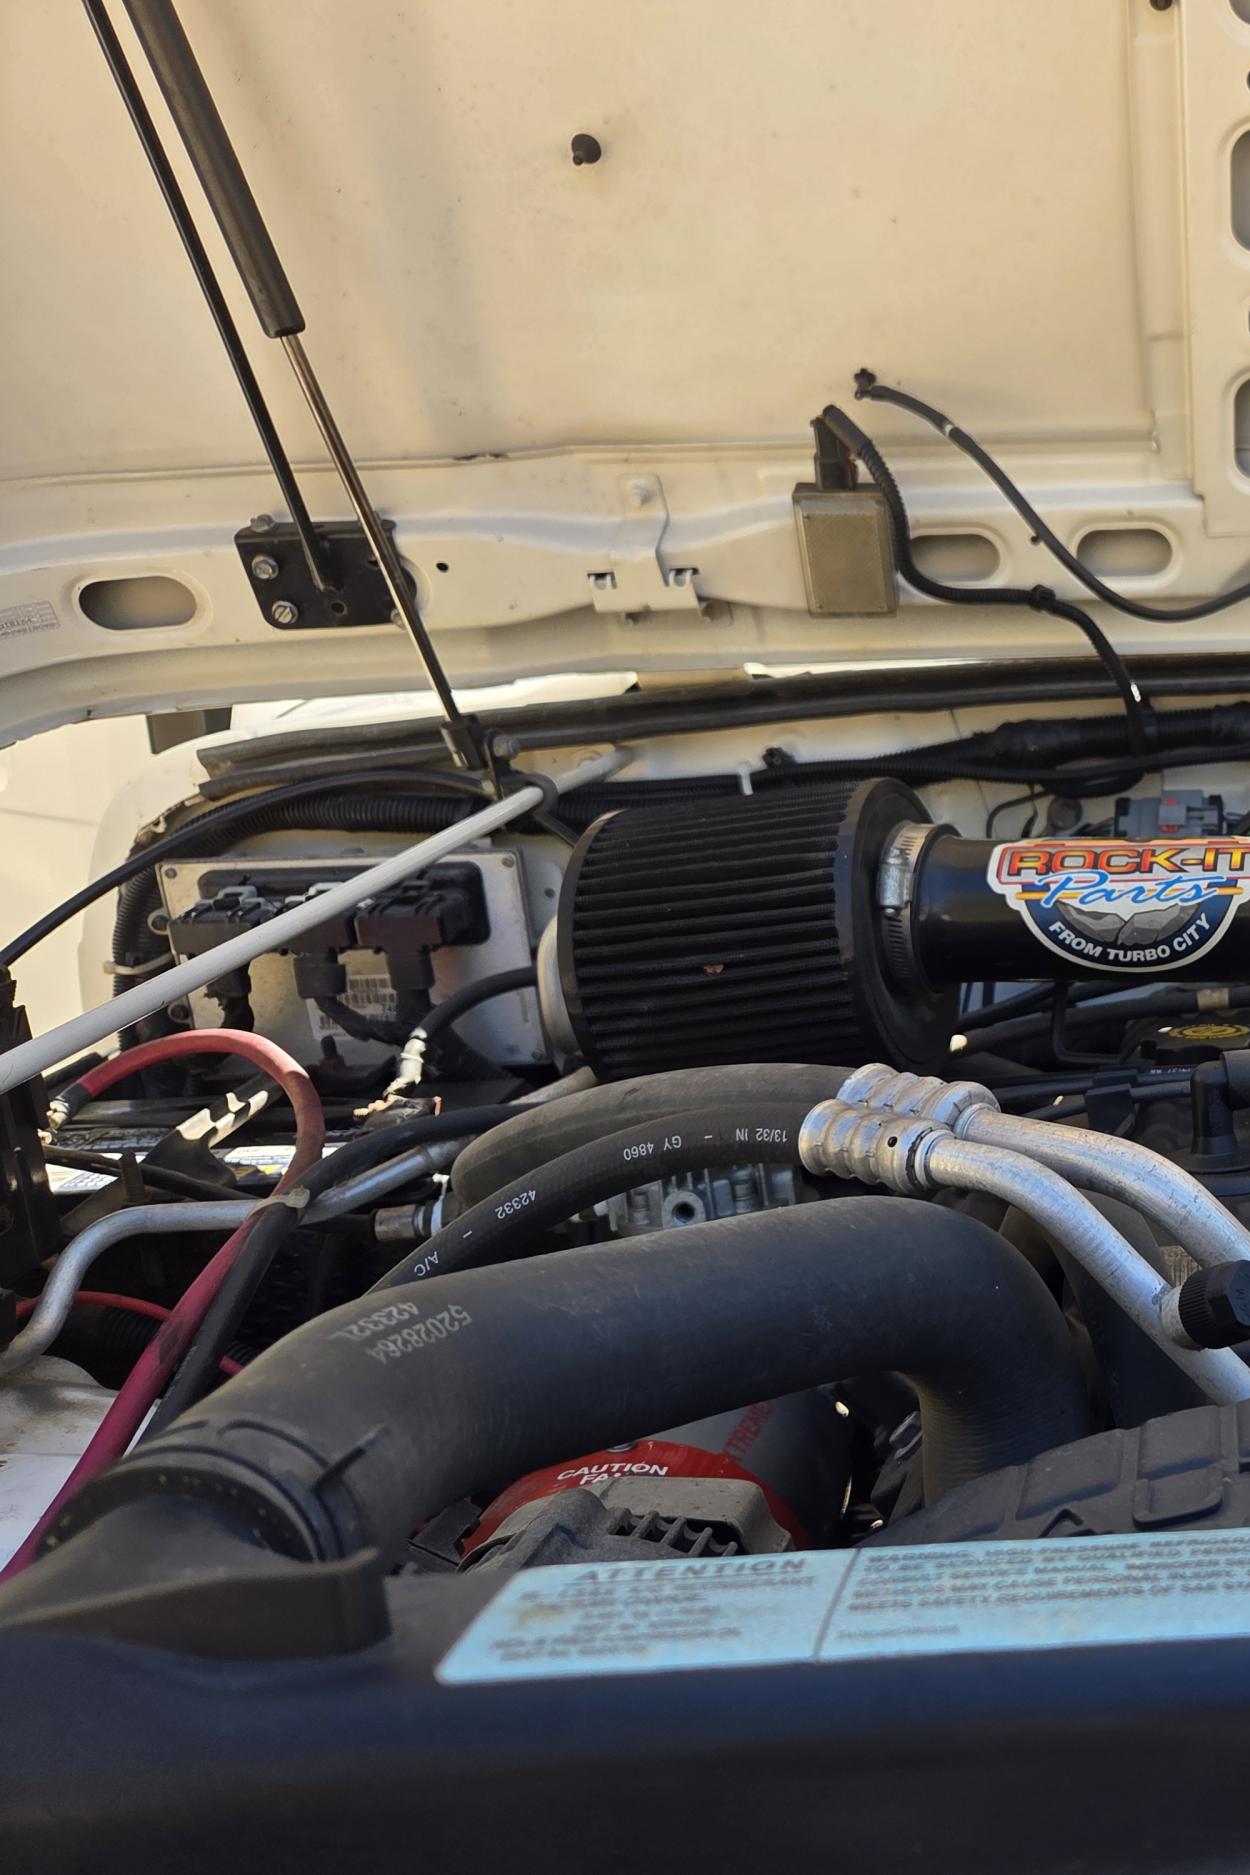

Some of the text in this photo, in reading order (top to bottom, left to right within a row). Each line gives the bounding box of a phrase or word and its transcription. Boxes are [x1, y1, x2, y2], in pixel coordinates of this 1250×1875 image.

[1036, 869, 1227, 908] Parts
[1048, 912, 1211, 963] FROM TURBO CITY
[662, 1134, 683, 1150] GY
[735, 1126, 749, 1142] IN
[755, 1126, 788, 1145] 13/32
[623, 1138, 656, 1162] 4860
[495, 1189, 537, 1220] 42332
[414, 1251, 440, 1278] A/C
[556, 1462, 669, 1481] CAUTION
[573, 1557, 807, 1584] ATTENTION
[935, 1556, 1033, 1569] SERVICED
[1077, 1548, 1181, 1561] QUALIFIED
[858, 1572, 945, 1587] CONSULT
[950, 1566, 1030, 1580] SERVICE
[1124, 1558, 1221, 1571] IMPROPER
[993, 1576, 1058, 1590] CAUSE
[1062, 1571, 1163, 1586] PERSONAL
[848, 1598, 914, 1613] MEETS
[918, 1594, 993, 1608] SAFETY
[995, 1584, 1145, 1603] REQUIREMENTS
[1147, 1583, 1176, 1595] OF
[1180, 1581, 1218, 1593] SAE
